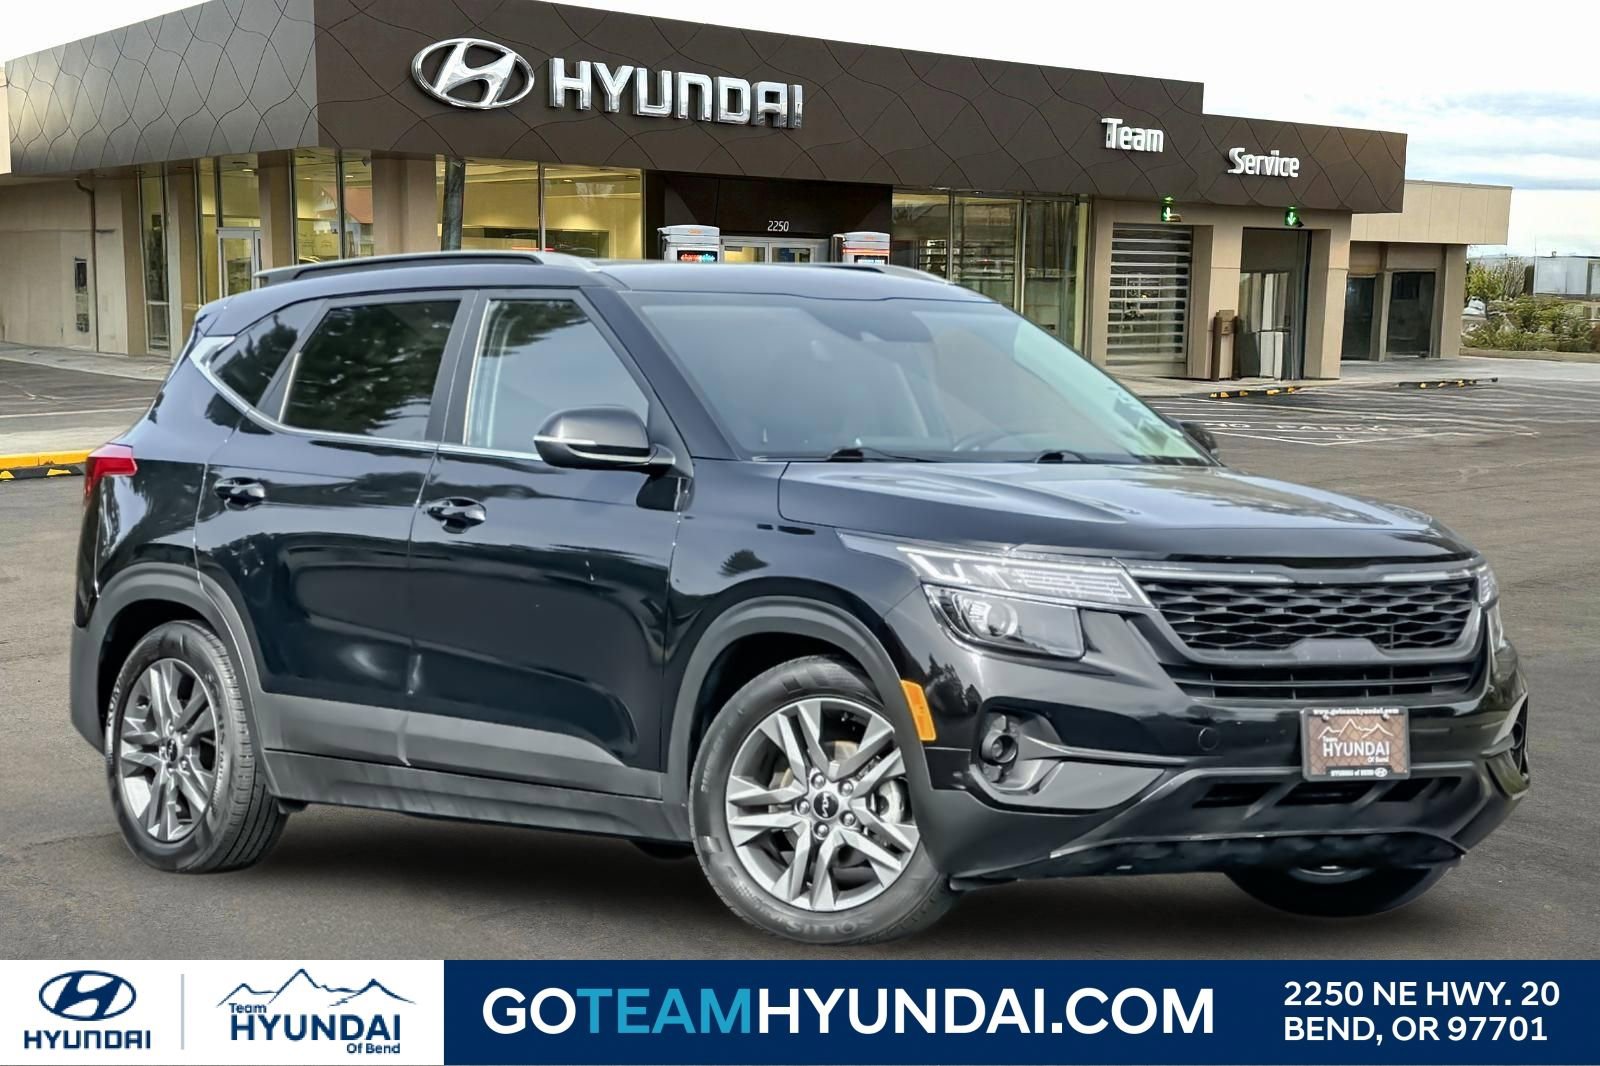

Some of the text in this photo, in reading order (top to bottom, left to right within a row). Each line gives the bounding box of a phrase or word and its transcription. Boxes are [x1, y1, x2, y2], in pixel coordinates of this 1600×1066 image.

[549, 57, 803, 129] HYUNDAI
[1101, 117, 1164, 153] Team
[1227, 147, 1300, 178] Service
[767, 220, 790, 232] 2250
[1323, 741, 1390, 757] HYUNDAI
